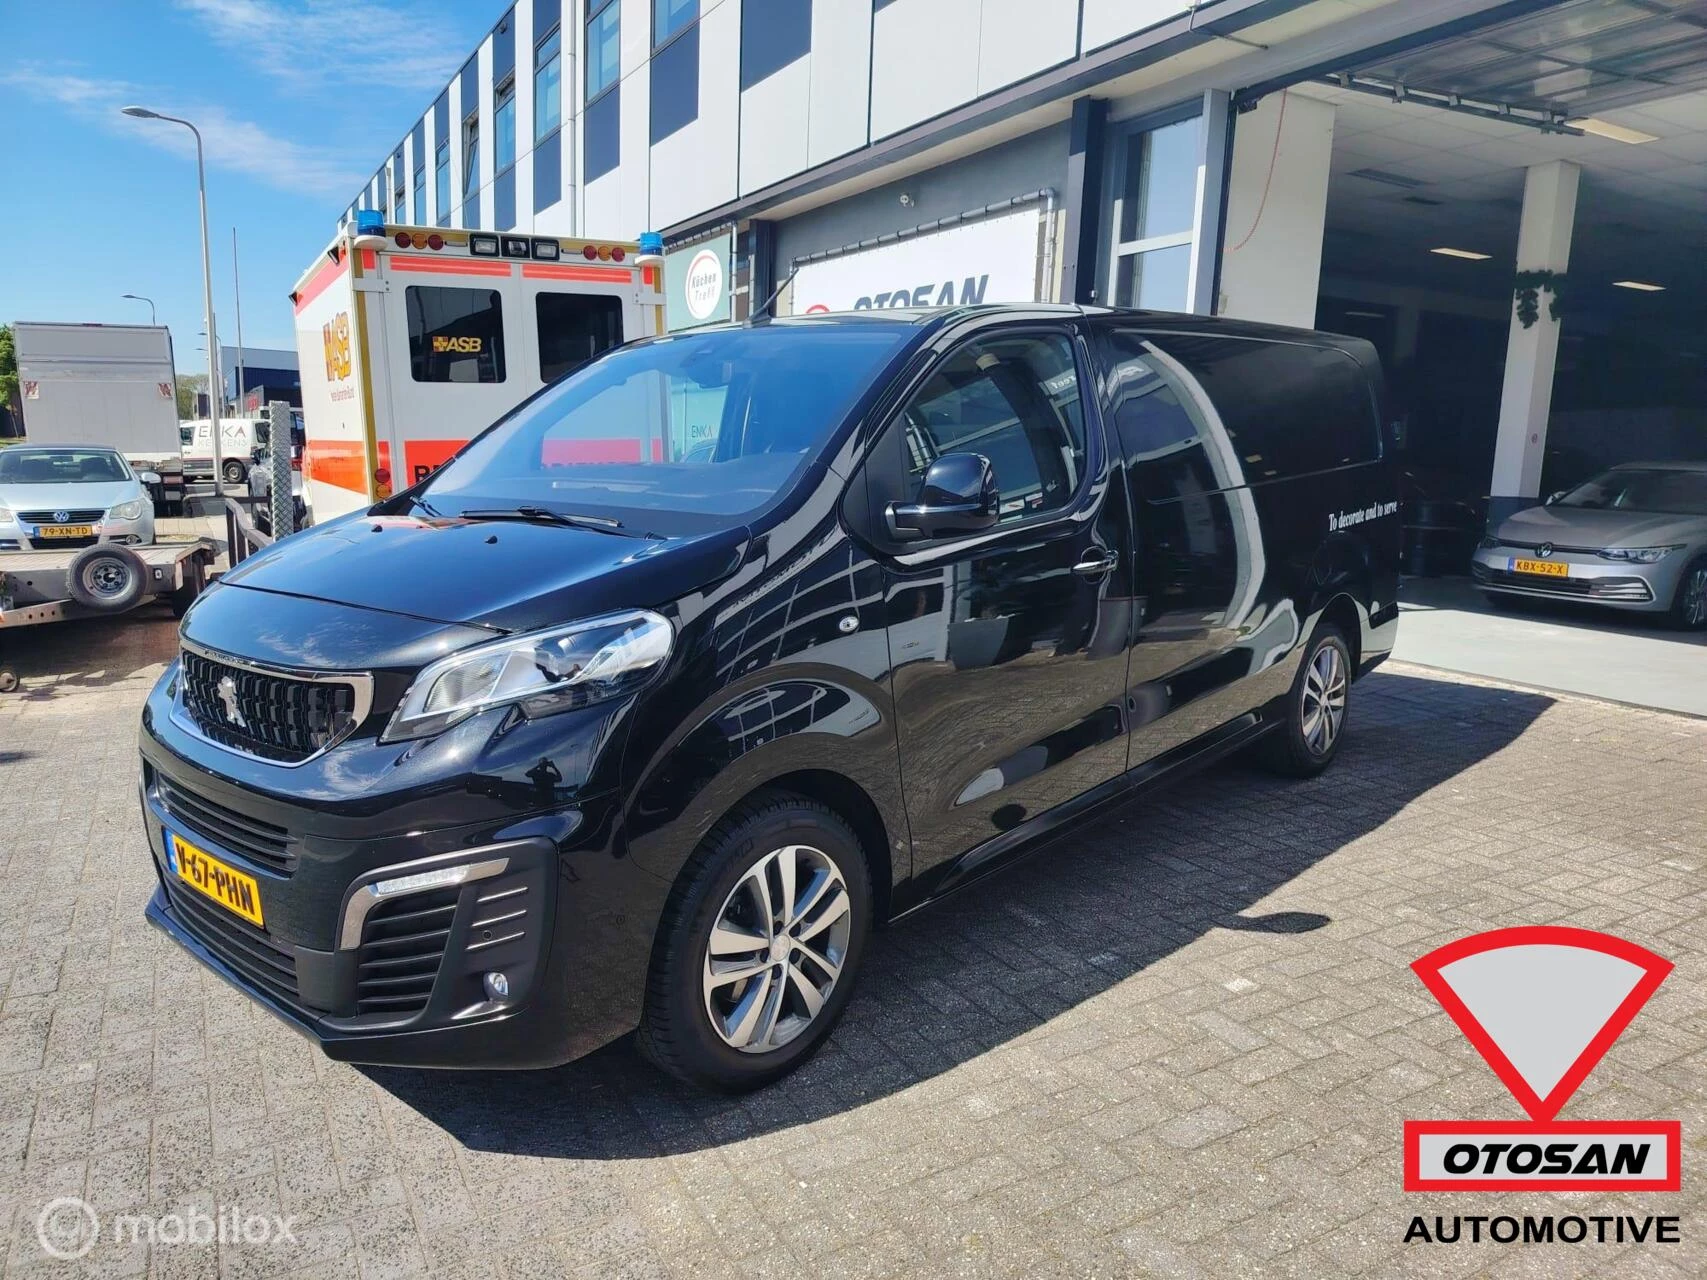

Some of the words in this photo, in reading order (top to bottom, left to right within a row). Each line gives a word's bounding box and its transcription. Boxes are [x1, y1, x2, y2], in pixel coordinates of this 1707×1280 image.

[446, 337, 482, 352] ASB
[198, 425, 247, 438] EKA
[1328, 513, 1338, 531] To
[1338, 510, 1365, 529] decorate
[1365, 501, 1377, 520] and
[1377, 503, 1384, 517] to
[1384, 501, 1398, 515] serve
[42, 527, 88, 536] 79-XN-TD
[1516, 560, 1564, 574] KBX-52-X
[174, 842, 256, 916] V-67-PHN
